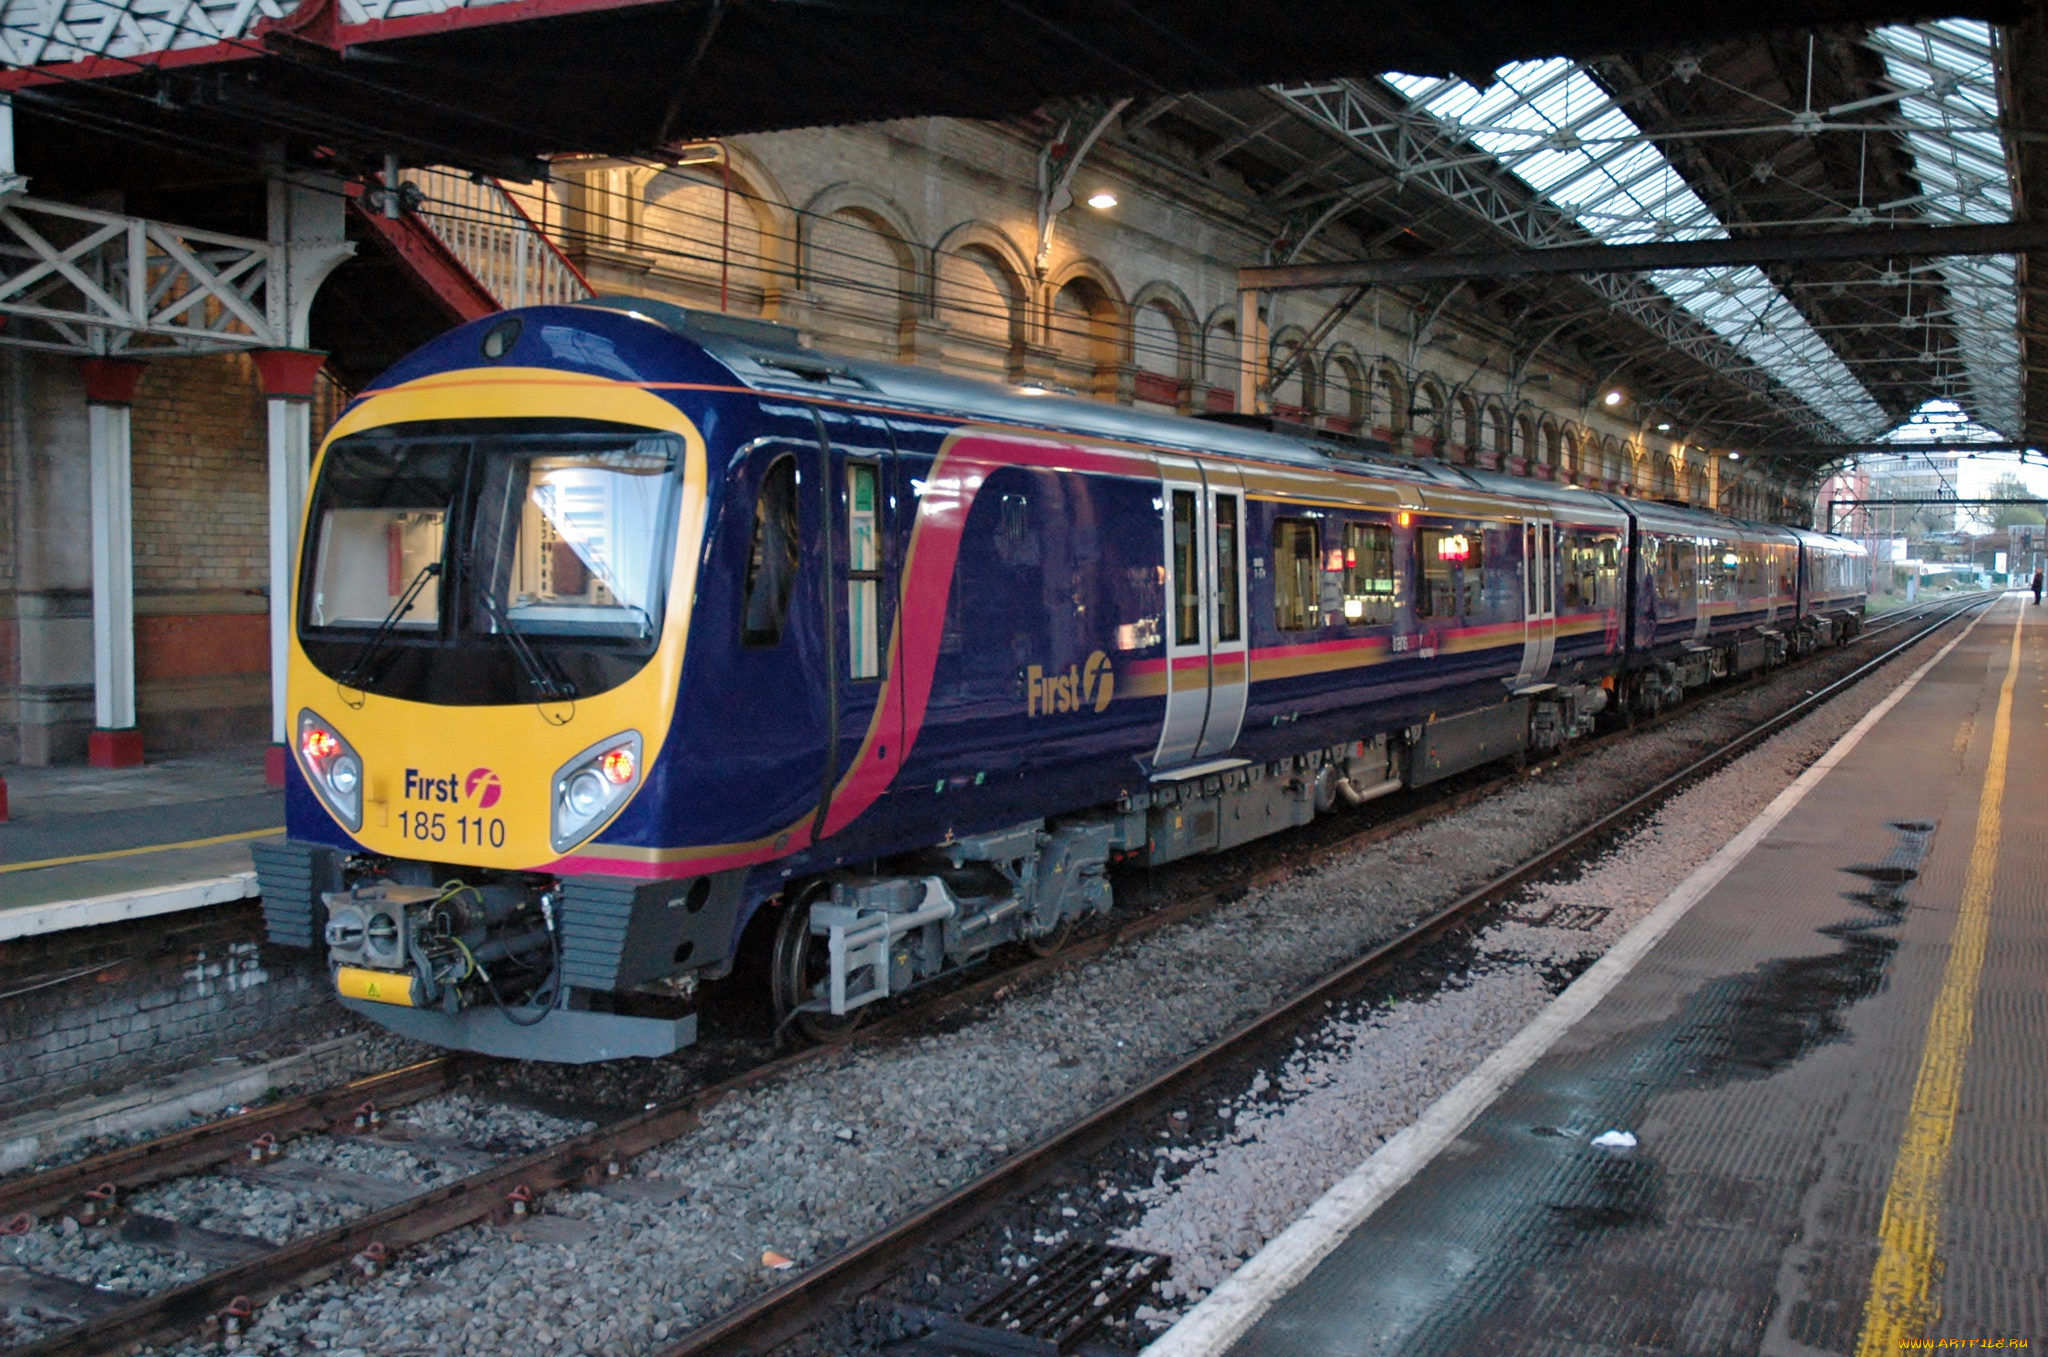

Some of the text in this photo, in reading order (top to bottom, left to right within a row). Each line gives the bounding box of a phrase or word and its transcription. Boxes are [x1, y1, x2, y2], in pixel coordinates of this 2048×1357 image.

[1027, 664, 1080, 718] First
[405, 768, 459, 804] First
[398, 810, 506, 849] 185 110
